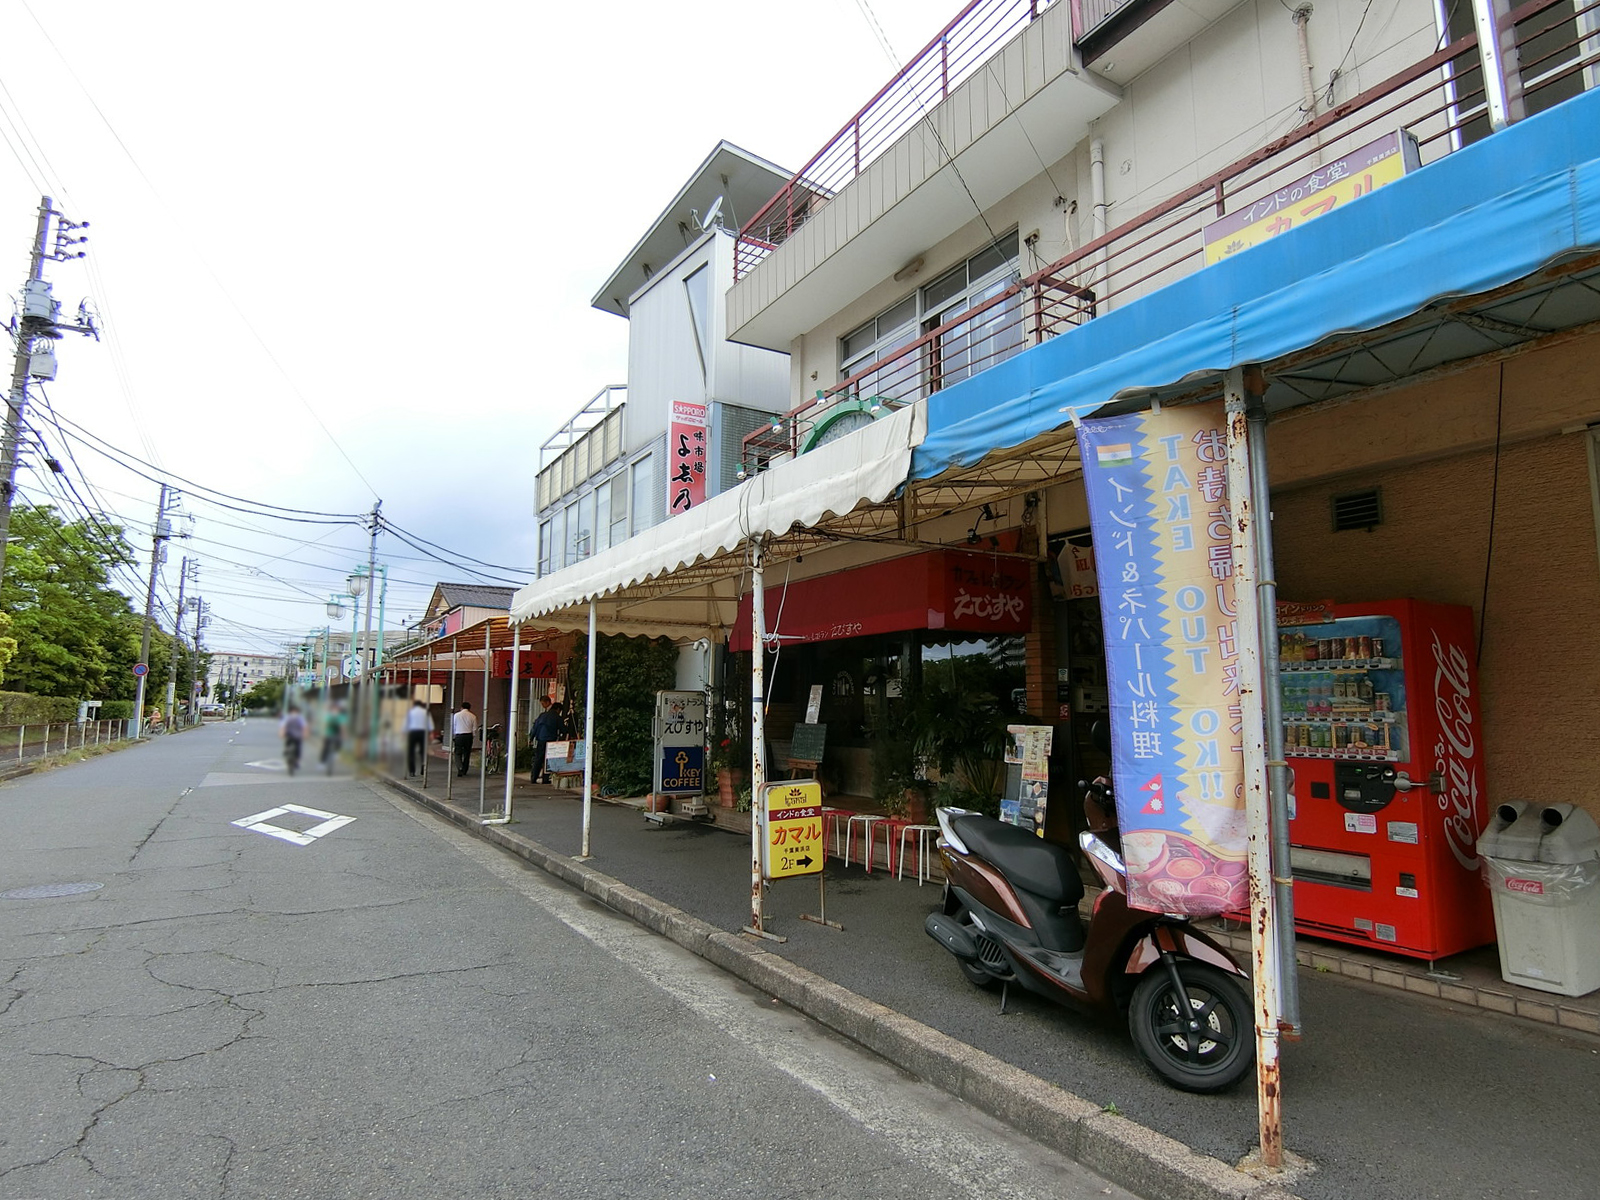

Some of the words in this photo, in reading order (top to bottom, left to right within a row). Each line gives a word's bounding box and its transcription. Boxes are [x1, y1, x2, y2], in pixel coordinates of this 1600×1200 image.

[1243, 160, 1350, 222] インドの食堂
[693, 430, 705, 473] 味市場
[953, 587, 1025, 623] えびすや
[831, 622, 862, 637] えびすや
[1431, 627, 1481, 871] Coca-Cola
[683, 768, 701, 778] KEY
[663, 778, 700, 788] COFFEE
[777, 808, 815, 819] インドの食堂
[772, 823, 822, 845] カマル
[781, 856, 795, 871] 2F
[1507, 879, 1541, 893] Coca-Cola
